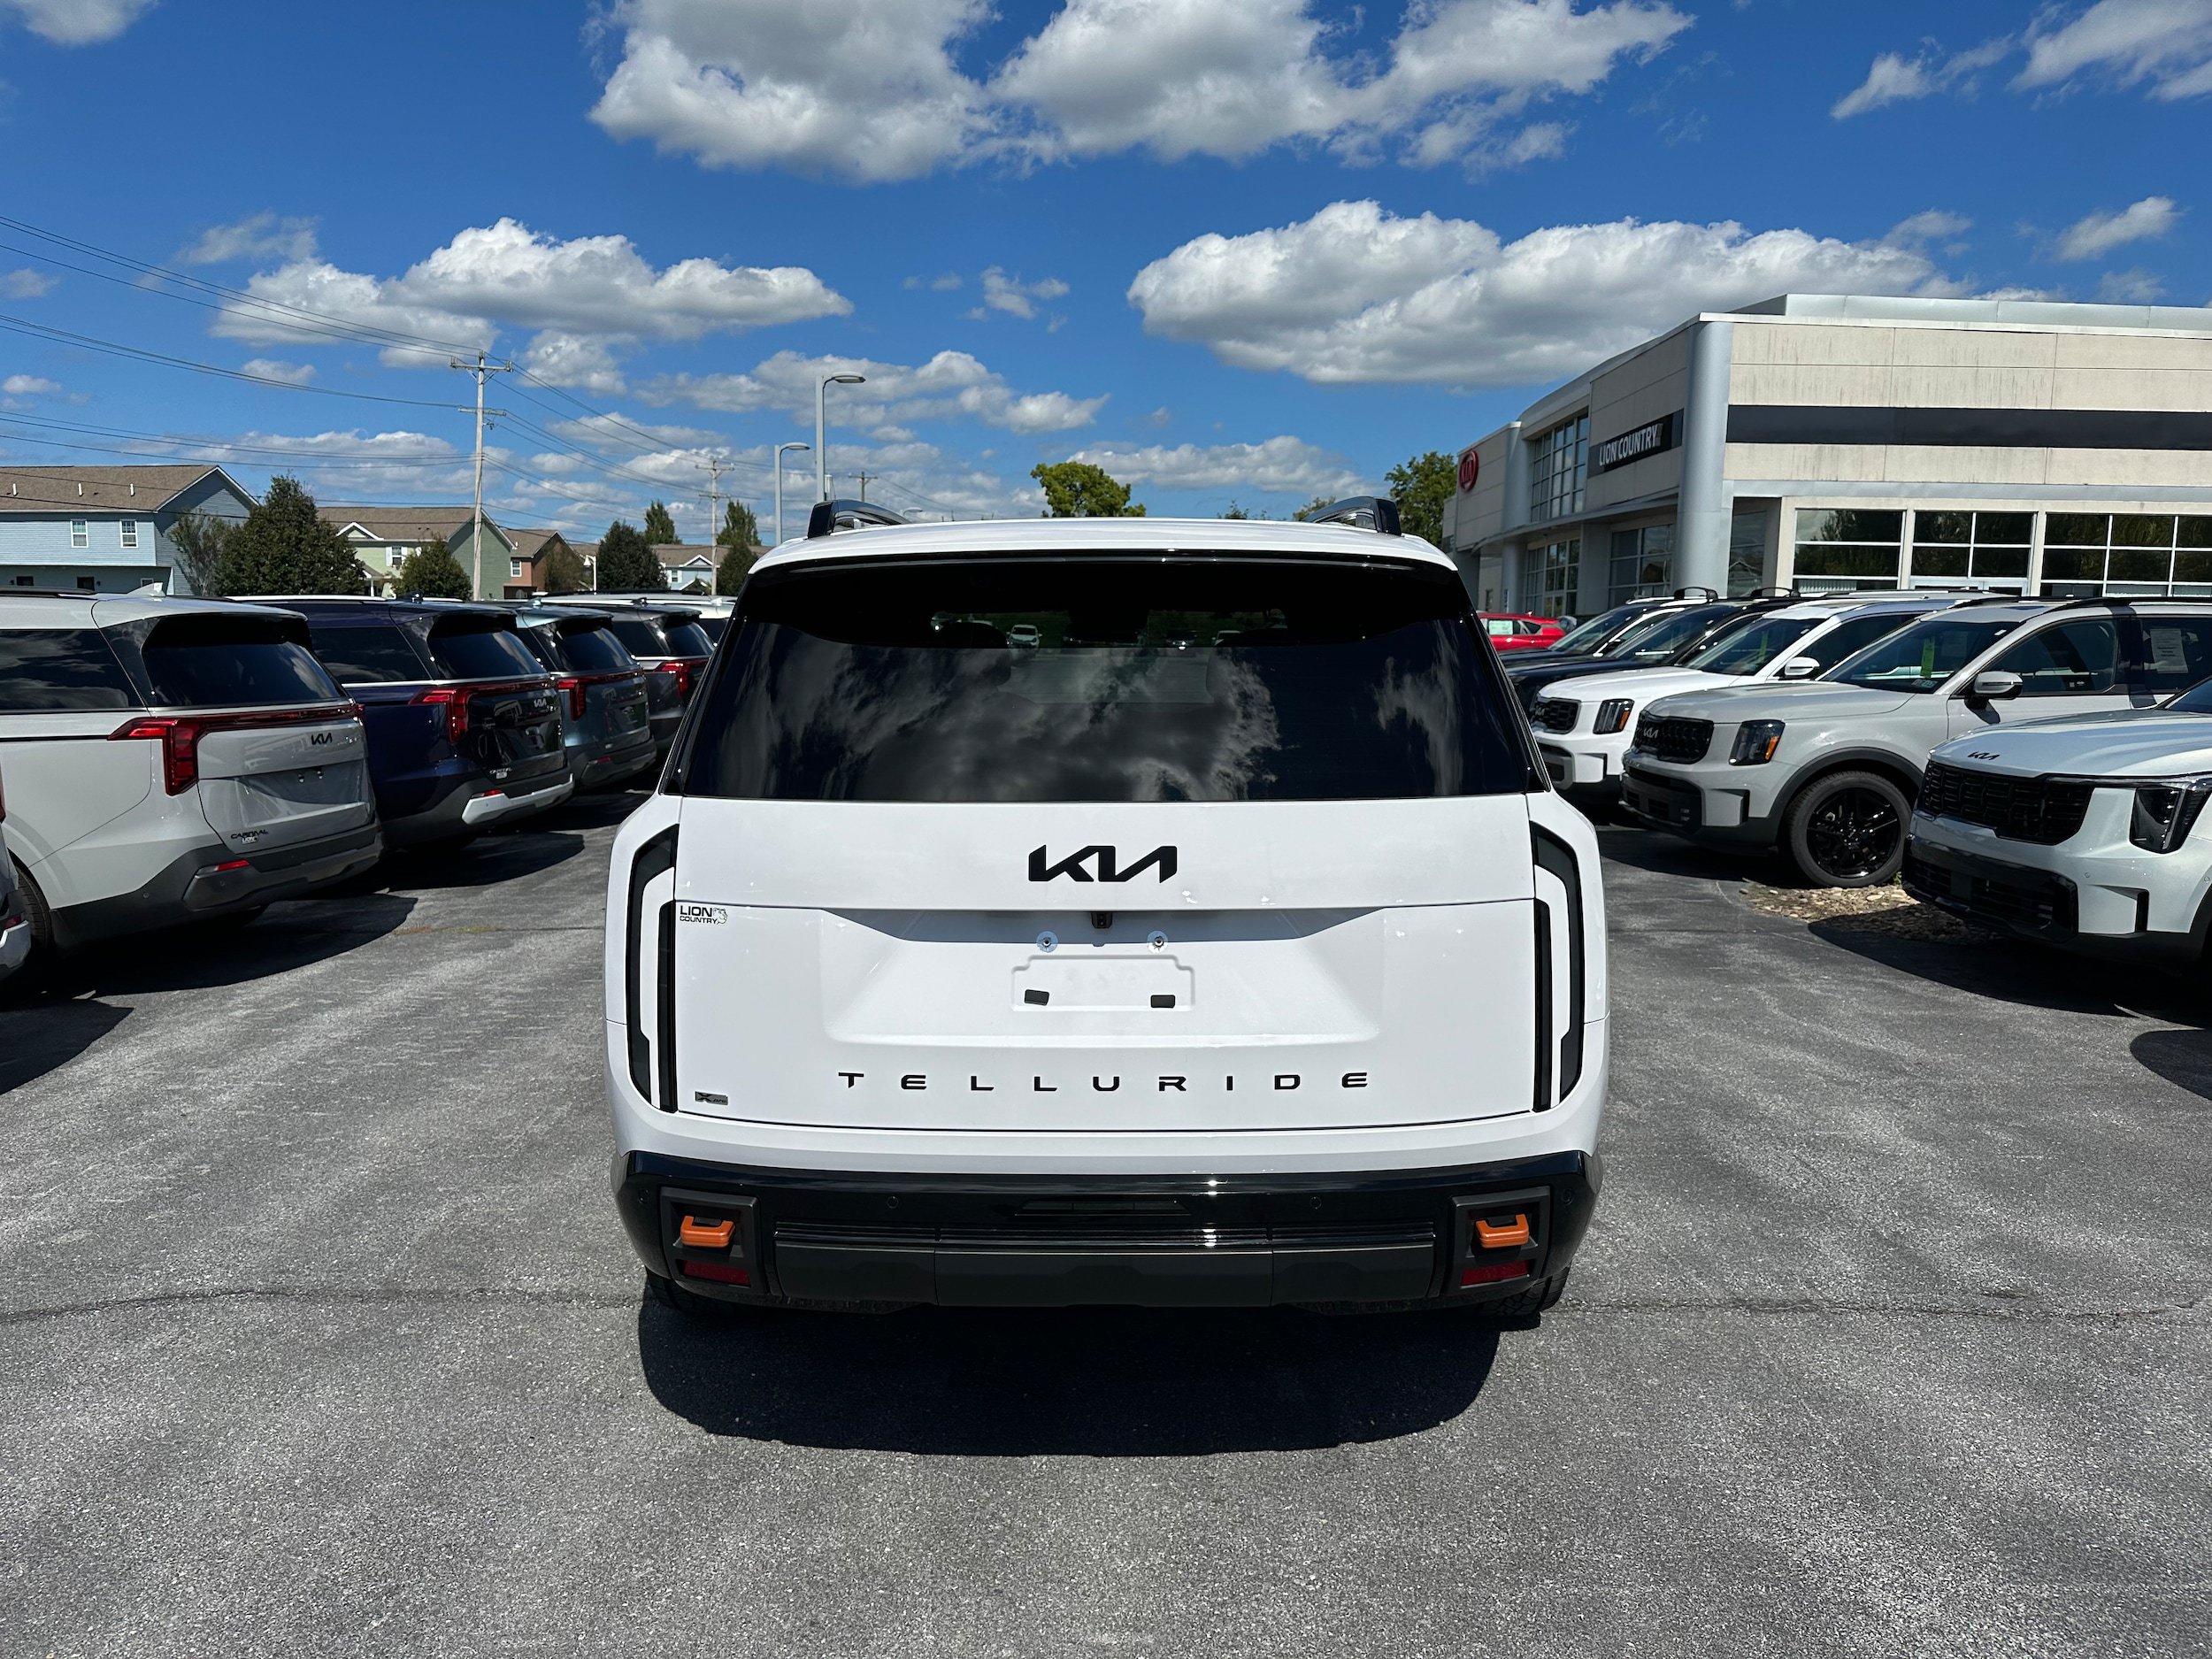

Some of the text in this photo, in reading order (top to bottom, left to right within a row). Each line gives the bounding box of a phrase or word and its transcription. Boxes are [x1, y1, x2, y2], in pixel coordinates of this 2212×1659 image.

[1599, 425, 1658, 466] LION COUNTRY
[534, 698, 547, 707] KIA
[1643, 727, 1658, 738] KIA
[311, 733, 333, 745] KIA
[1967, 751, 2001, 760] KIA
[1028, 844, 1178, 883] KIA
[680, 905, 712, 917] LION
[680, 915, 718, 925] COUNTRY
[838, 1071, 1368, 1092] TELLURIDE
